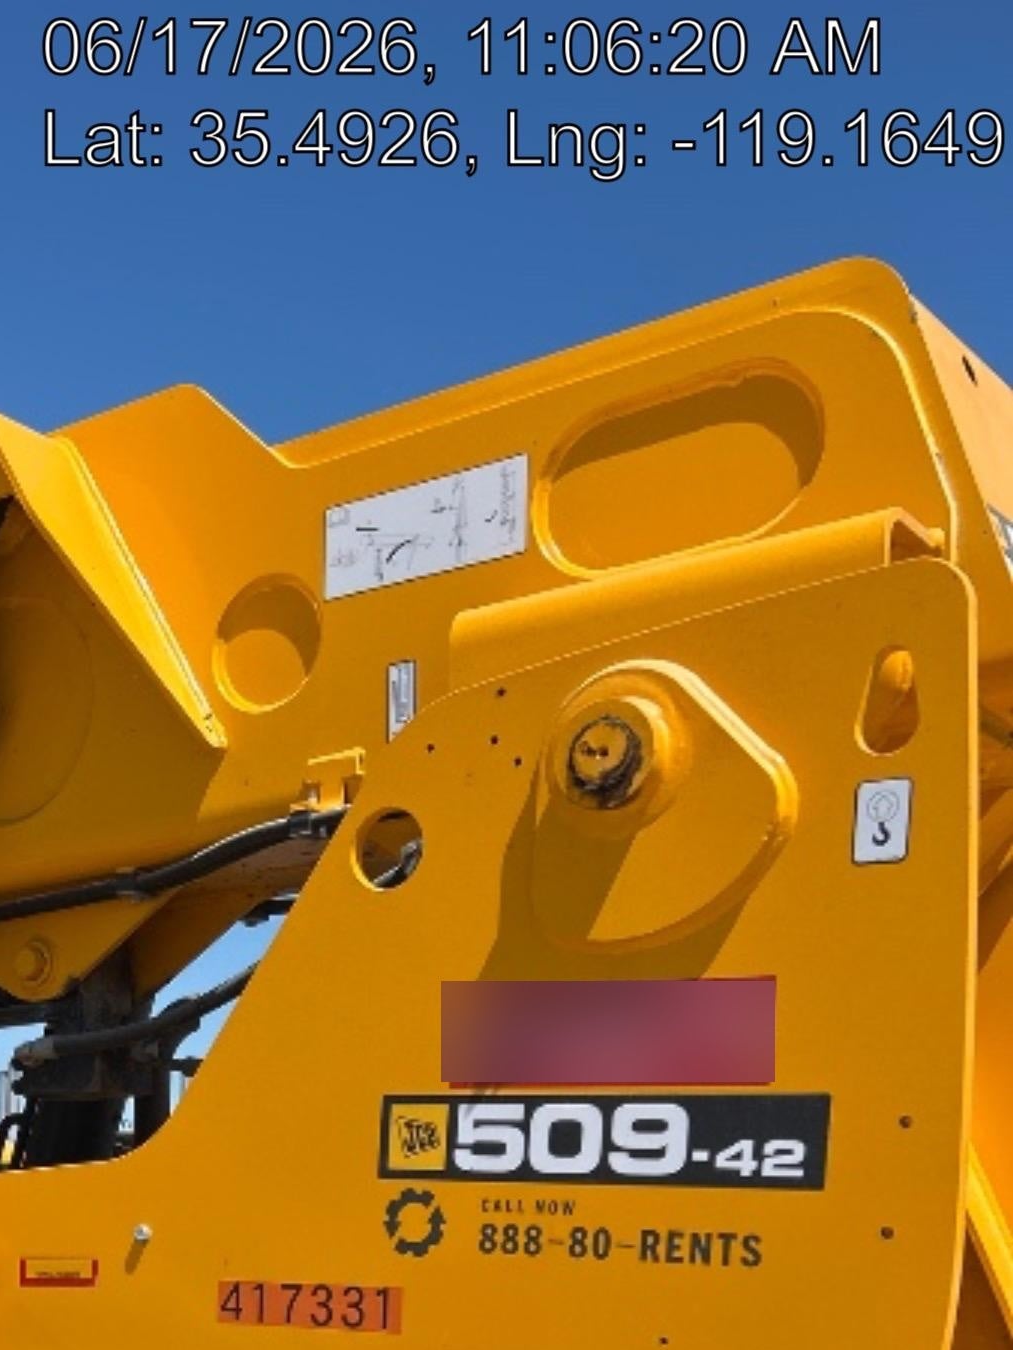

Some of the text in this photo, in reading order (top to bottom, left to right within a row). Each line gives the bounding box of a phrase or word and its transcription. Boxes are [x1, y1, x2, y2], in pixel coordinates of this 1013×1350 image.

[454, 1103, 805, 1177] 509-42
[481, 1198, 576, 1216] CALL NOW
[478, 1223, 763, 1268] 888-80-RENTS
[219, 1281, 390, 1330] 417331
